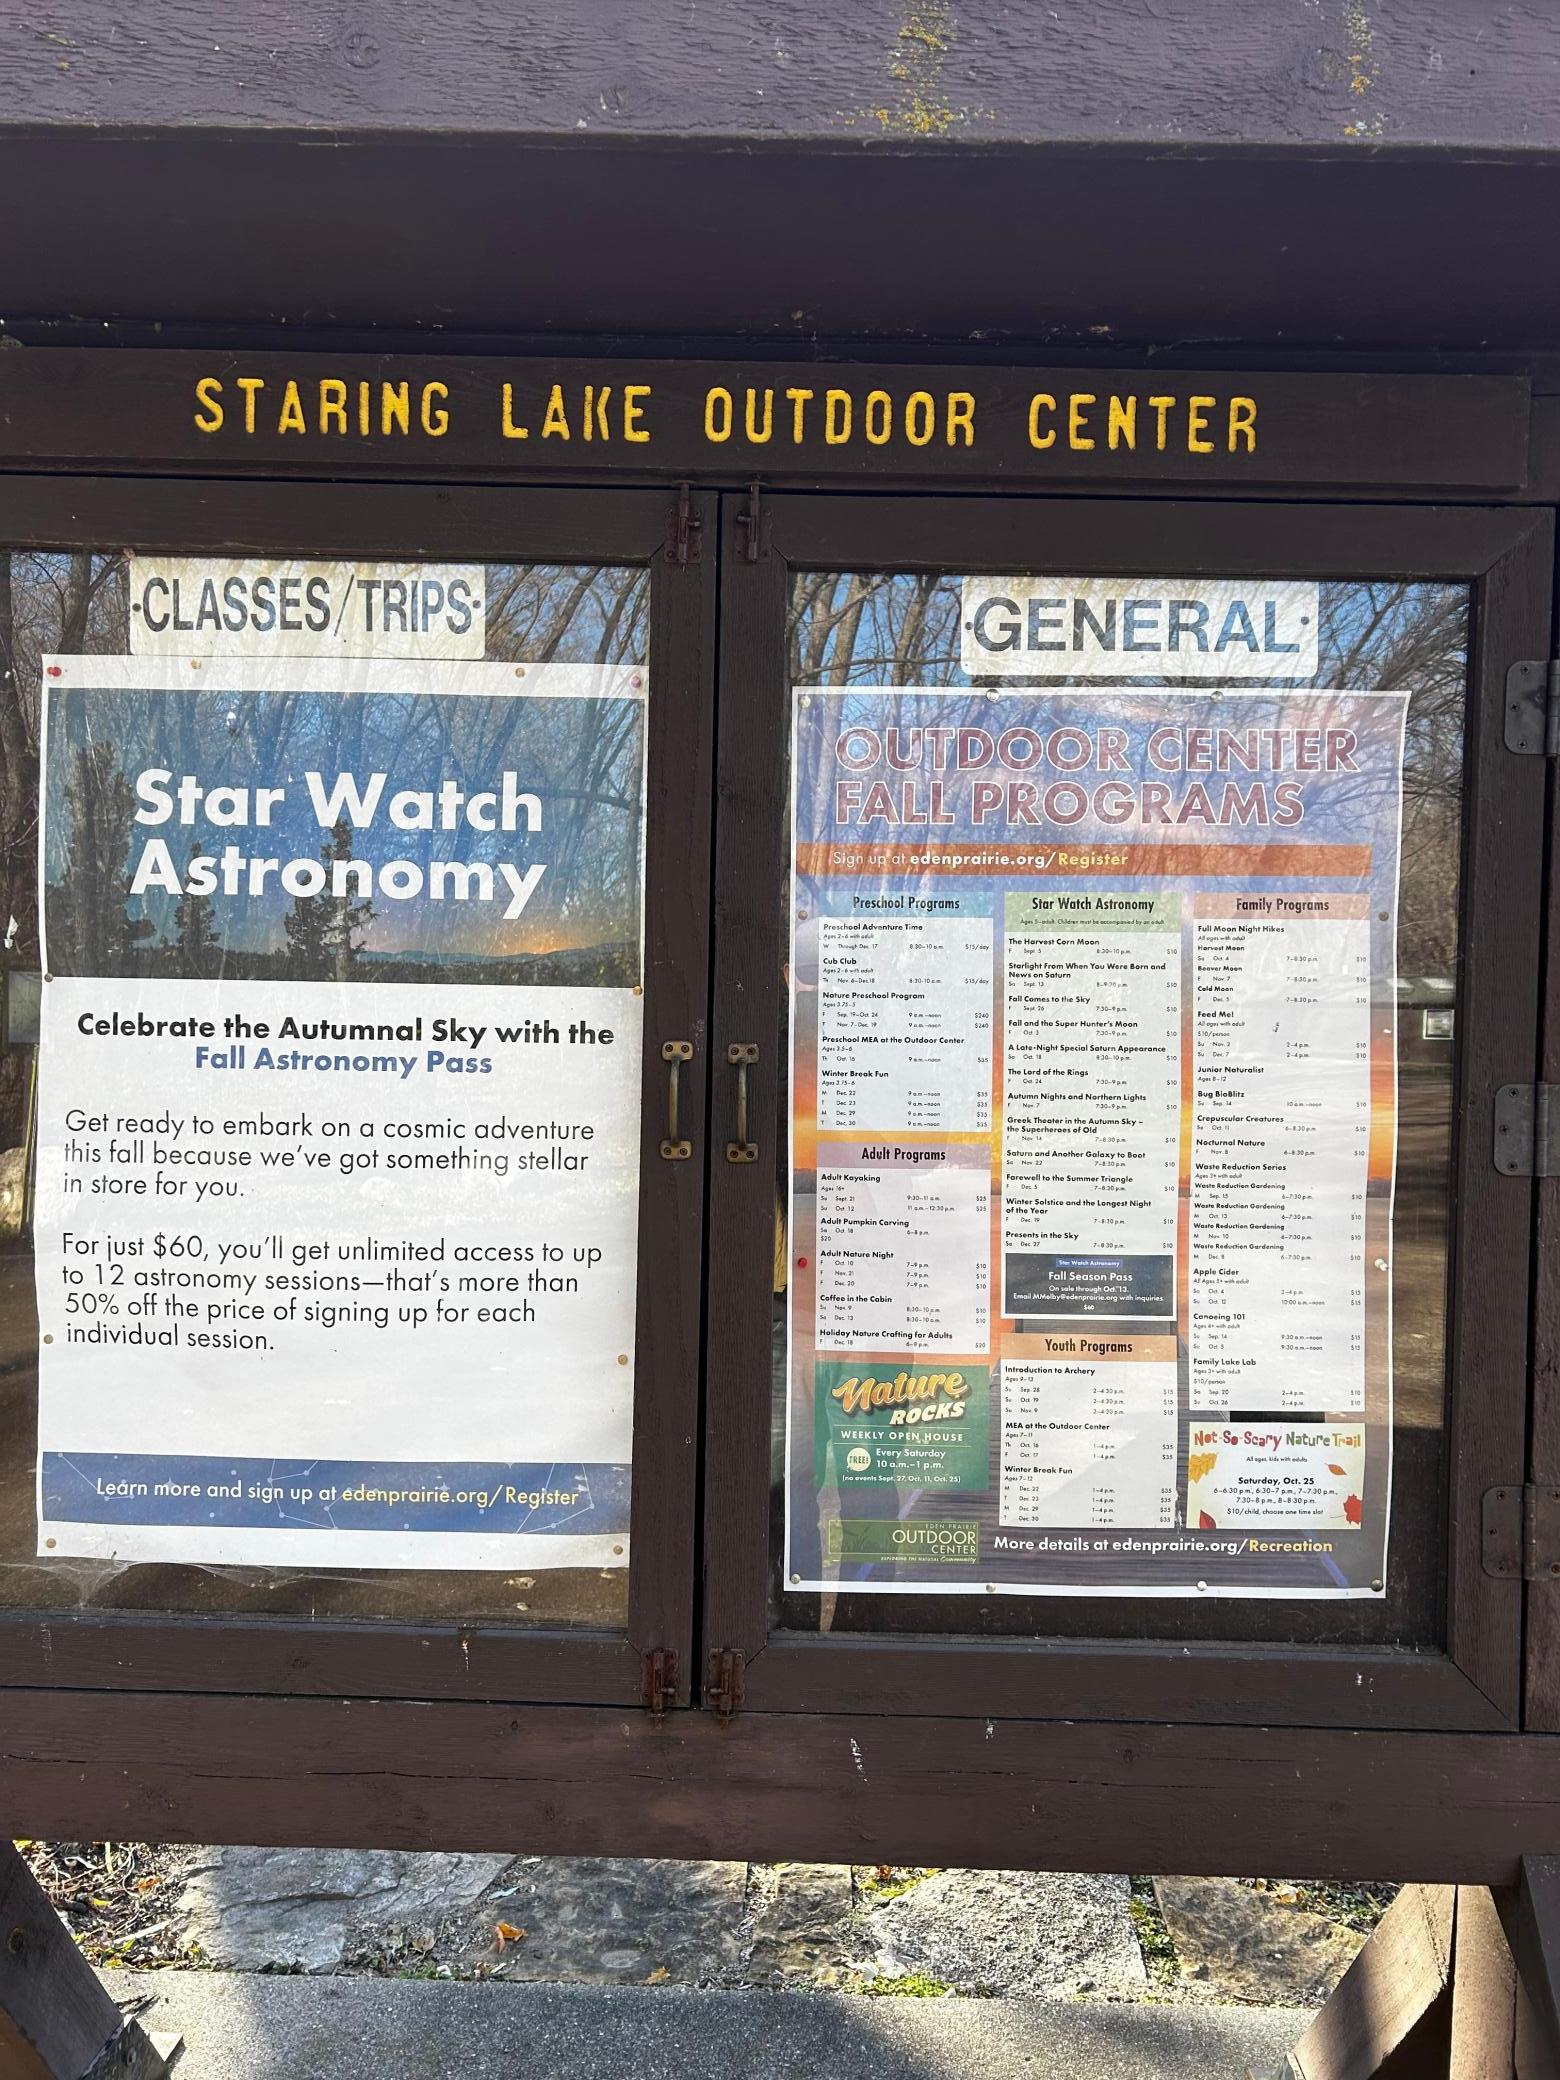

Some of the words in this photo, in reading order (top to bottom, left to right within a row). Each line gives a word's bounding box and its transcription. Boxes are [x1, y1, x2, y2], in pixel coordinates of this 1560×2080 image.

[195, 377, 449, 437] STARING
[502, 383, 652, 443] LAKE
[705, 387, 976, 448] OUTDOOR
[1028, 393, 1257, 455] CENTER
[973, 597, 1300, 654] GENERAL
[836, 727, 1131, 773] OUTDOOR
[1147, 727, 1360, 774] CENTER
[134, 769, 285, 827] Star
[304, 771, 542, 832] Watch
[835, 780, 955, 826] FALL
[971, 781, 1305, 827] PROGRAMS
[833, 850, 869, 869] Sign
[872, 855, 887, 869] up
[890, 853, 906, 866] at
[129, 838, 547, 920] Astronomy
[853, 896, 904, 909] Preschool
[908, 897, 960, 912] Programs
[1032, 898, 1054, 910] Star
[1058, 897, 1092, 910] Watch
[1095, 898, 1154, 913] Astronomy
[1236, 898, 1272, 913] Family
[1276, 899, 1329, 913] Programs
[823, 923, 861, 931] Preschool
[905, 923, 923, 931] Time
[1238, 926, 1260, 935] Night
[1009, 995, 1022, 1003] Fall
[1076, 996, 1090, 1005] Sky
[77, 1013, 215, 1040] Celebrate
[224, 1014, 270, 1040] the
[278, 1016, 423, 1042] Autumnal
[431, 1018, 486, 1049] Sky
[494, 1020, 560, 1045] with
[568, 1022, 614, 1046] the
[195, 1047, 244, 1070] Fall
[254, 1048, 417, 1079] Astronomy
[426, 1050, 493, 1074] Pass
[65, 1110, 108, 1134] Get
[117, 1111, 184, 1141] ready
[192, 1113, 214, 1136] to
[223, 1112, 313, 1138] embark
[321, 1120, 350, 1138] on
[359, 1122, 375, 1139] a
[384, 1119, 466, 1140] cosmic
[474, 1118, 594, 1141] adventure
[64, 1142, 103, 1164] this
[109, 1141, 146, 1165] fall
[153, 1142, 252, 1167] because
[339, 1149, 379, 1176] got
[386, 1147, 509, 1177] something
[517, 1146, 588, 1172] stellar
[862, 1148, 890, 1159] Adult
[894, 1148, 946, 1162] Programs
[64, 1172, 82, 1194] in
[90, 1175, 148, 1195] store
[155, 1173, 187, 1196] for
[195, 1179, 244, 1201] you.
[844, 1174, 881, 1183] Kayaking
[1064, 1232, 1078, 1240] Sky
[62, 1233, 98, 1257] For
[105, 1236, 144, 1262] just
[154, 1236, 209, 1261] $60,
[292, 1242, 329, 1266] get
[338, 1240, 444, 1263] unlimited
[454, 1244, 534, 1263] access
[542, 1243, 564, 1263] to
[573, 1247, 602, 1271] up
[62, 1265, 83, 1285] to
[96, 1264, 125, 1286] 12
[134, 1268, 256, 1295] astronomy
[458, 1273, 519, 1293] more
[527, 1270, 578, 1293] than
[1049, 1272, 1066, 1280] Fall
[1070, 1273, 1106, 1281] Season
[1110, 1273, 1133, 1281] Pass
[65, 1293, 120, 1316] 50%
[127, 1294, 157, 1316] off
[165, 1295, 199, 1317] the
[207, 1298, 265, 1325] price
[273, 1300, 297, 1321] of
[304, 1298, 389, 1328] signing
[398, 1303, 428, 1328] up
[436, 1300, 469, 1324] for
[478, 1300, 535, 1324] each
[67, 1325, 178, 1346] individual
[187, 1328, 273, 1350] session.
[1045, 1339, 1076, 1351] Youth
[1080, 1340, 1133, 1354] Programs
[1194, 1358, 1219, 1367] Family
[1005, 1366, 1052, 1374] Introduction
[1065, 1367, 1095, 1376] Archery
[832, 1372, 968, 1412] Nature
[890, 1402, 965, 1425] ROCKS
[841, 1431, 883, 1440] WEEKLY
[889, 1432, 919, 1440] OPEN
[924, 1433, 963, 1442] HOUSE
[1286, 1432, 1330, 1447] Nature
[1332, 1433, 1360, 1448] Trail
[876, 1448, 901, 1458] Every
[904, 1449, 945, 1459] Saturday
[876, 1460, 887, 1468] 10
[924, 1461, 944, 1470] p.m.
[879, 1475, 895, 1483] Sept.
[1238, 1477, 1280, 1486] Saturday,
[97, 1477, 148, 1497] Learn
[154, 1482, 201, 1498] more
[207, 1481, 241, 1499] and
[248, 1482, 284, 1503] sign
[289, 1485, 313, 1505] up
[318, 1485, 337, 1502] at
[892, 1529, 976, 1544] OUTDOOR
[994, 1537, 1034, 1550] More
[1039, 1537, 1090, 1551] details
[1093, 1539, 1108, 1551] at
[932, 1545, 976, 1554] CENTER
